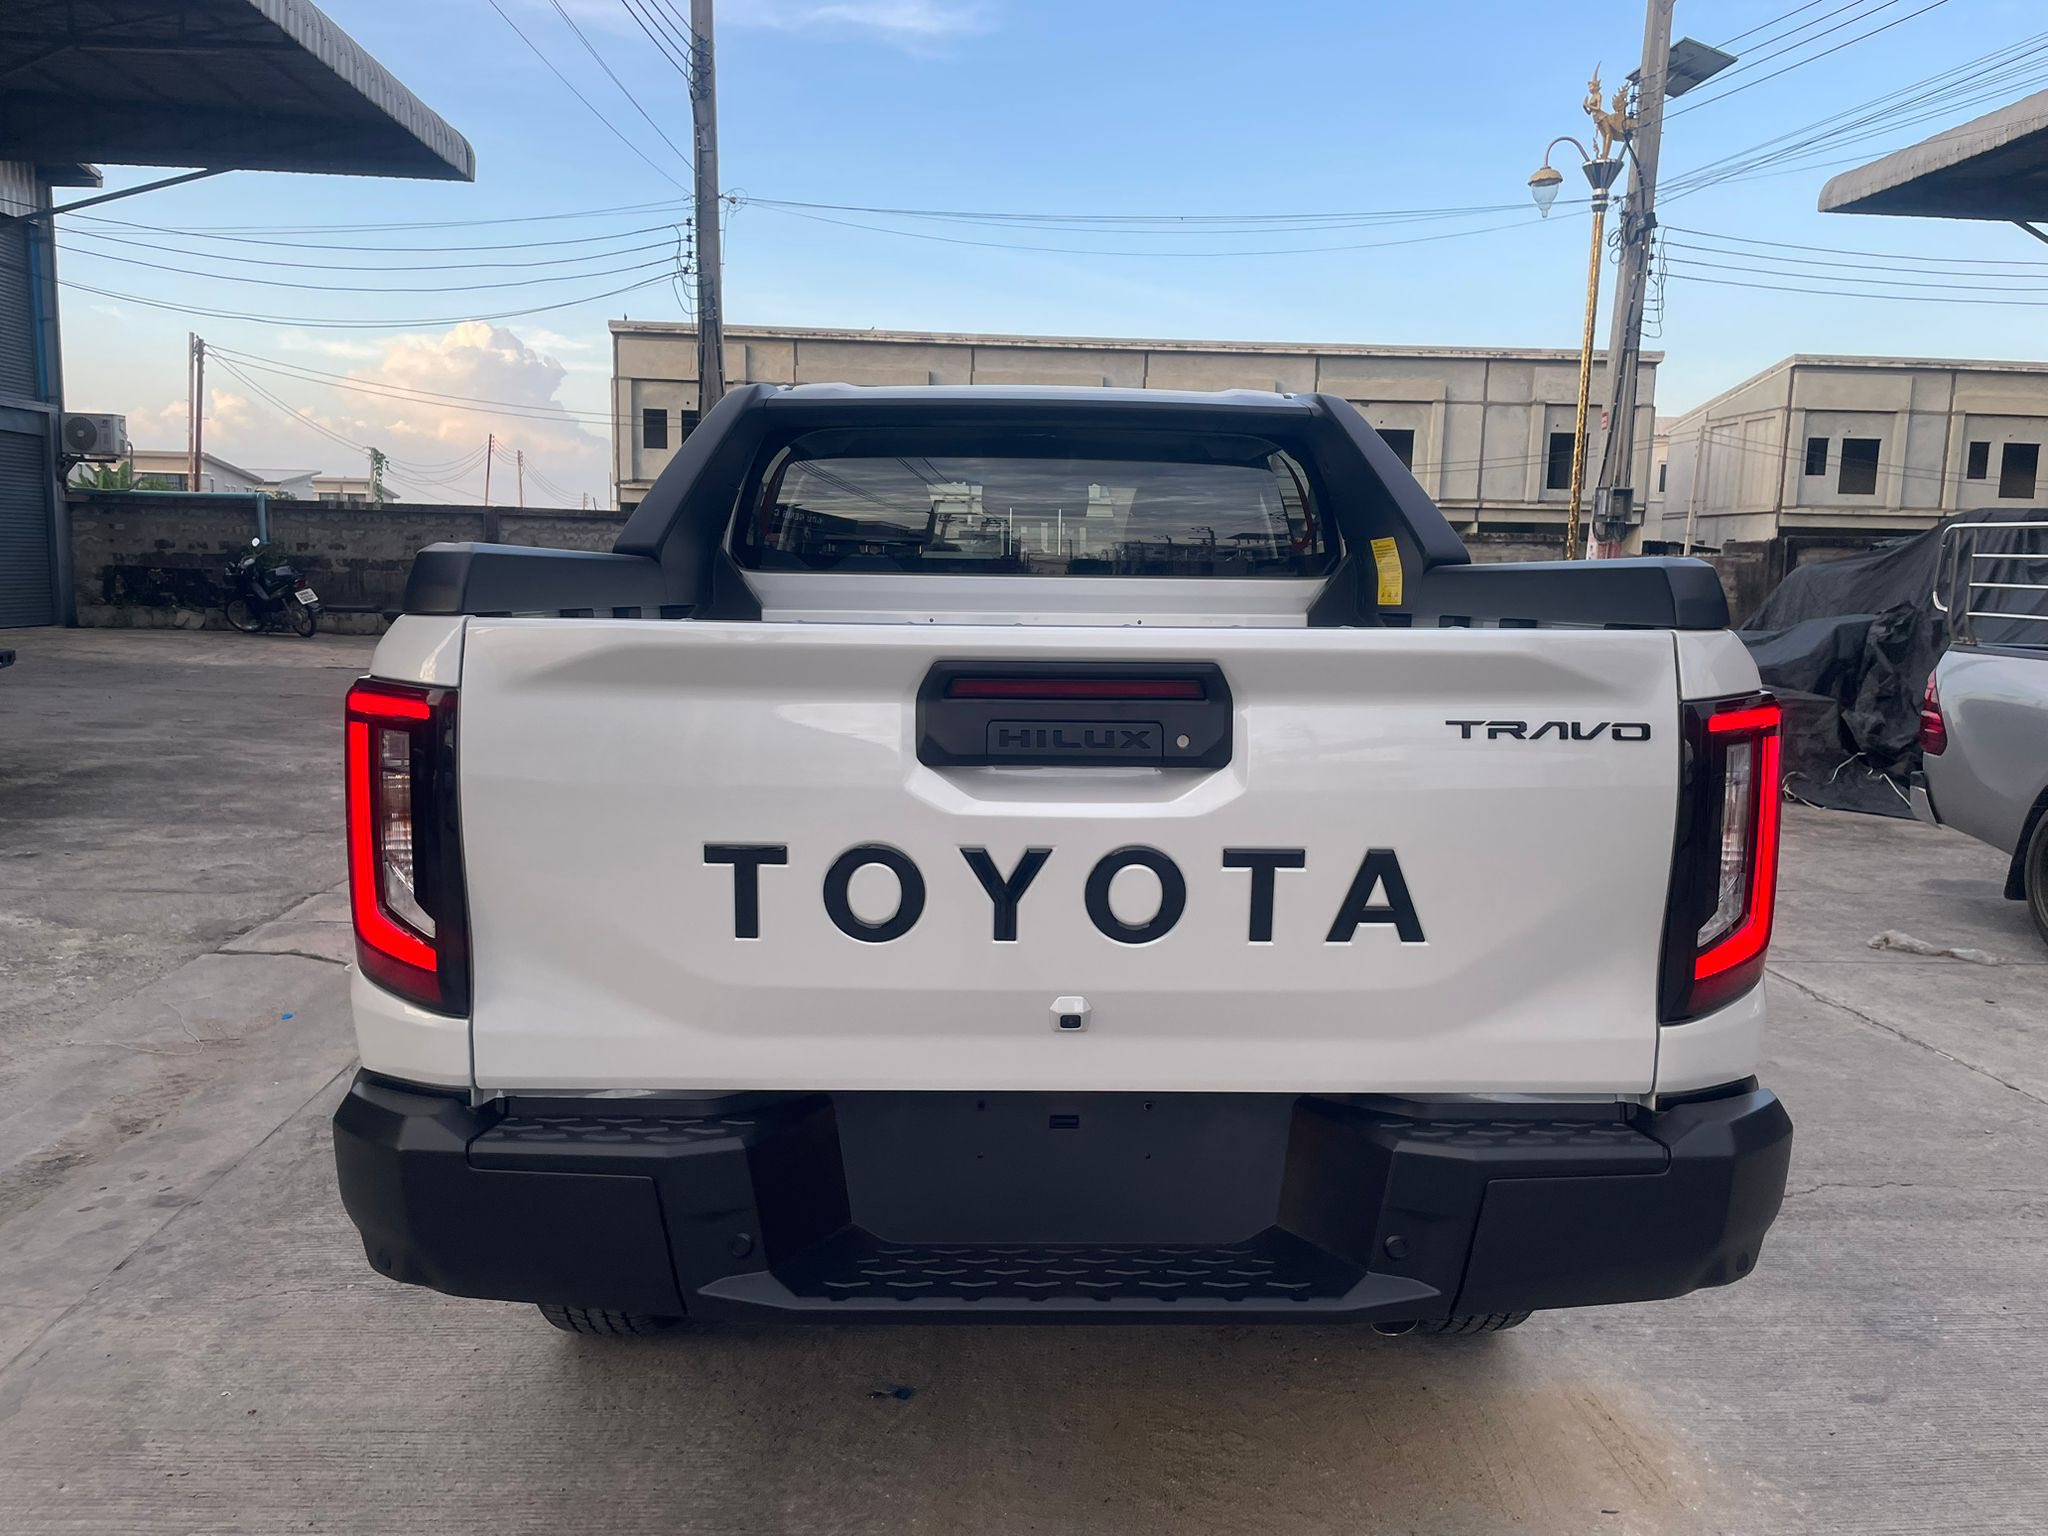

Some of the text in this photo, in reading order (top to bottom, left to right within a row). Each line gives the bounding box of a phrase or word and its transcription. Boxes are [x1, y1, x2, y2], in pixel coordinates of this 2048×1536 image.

[998, 728, 1152, 750] HILUX
[1445, 719, 1652, 742] TRAVO
[702, 842, 1428, 947] TOYOTA
